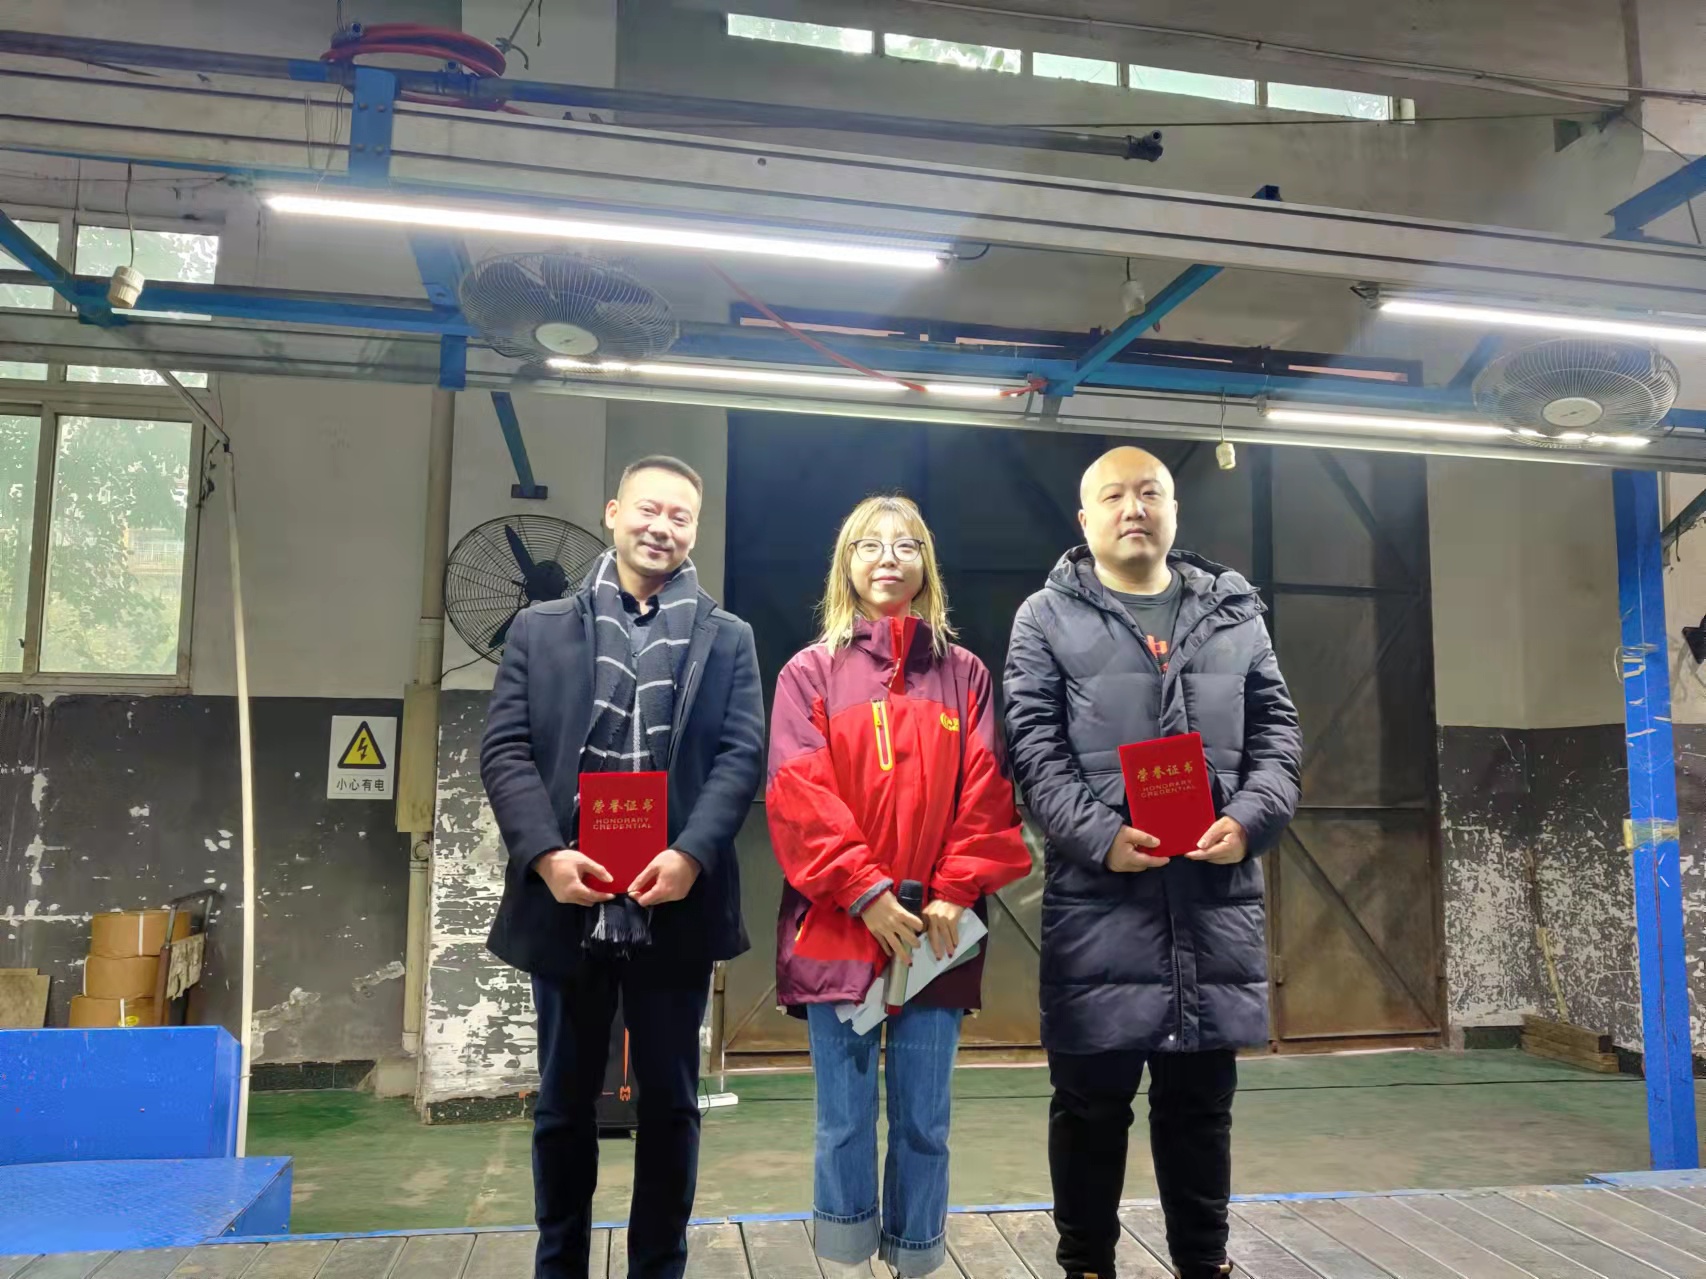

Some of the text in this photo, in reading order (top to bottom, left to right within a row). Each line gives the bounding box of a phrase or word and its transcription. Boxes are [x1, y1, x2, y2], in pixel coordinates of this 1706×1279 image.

[336, 778, 384, 791] 小心有电
[1143, 780, 1192, 792] HONORARY
[1141, 785, 1196, 798] CREDENTIAL
[593, 823, 652, 831] CREDENTIAL
[596, 817, 649, 825] HONORARY
